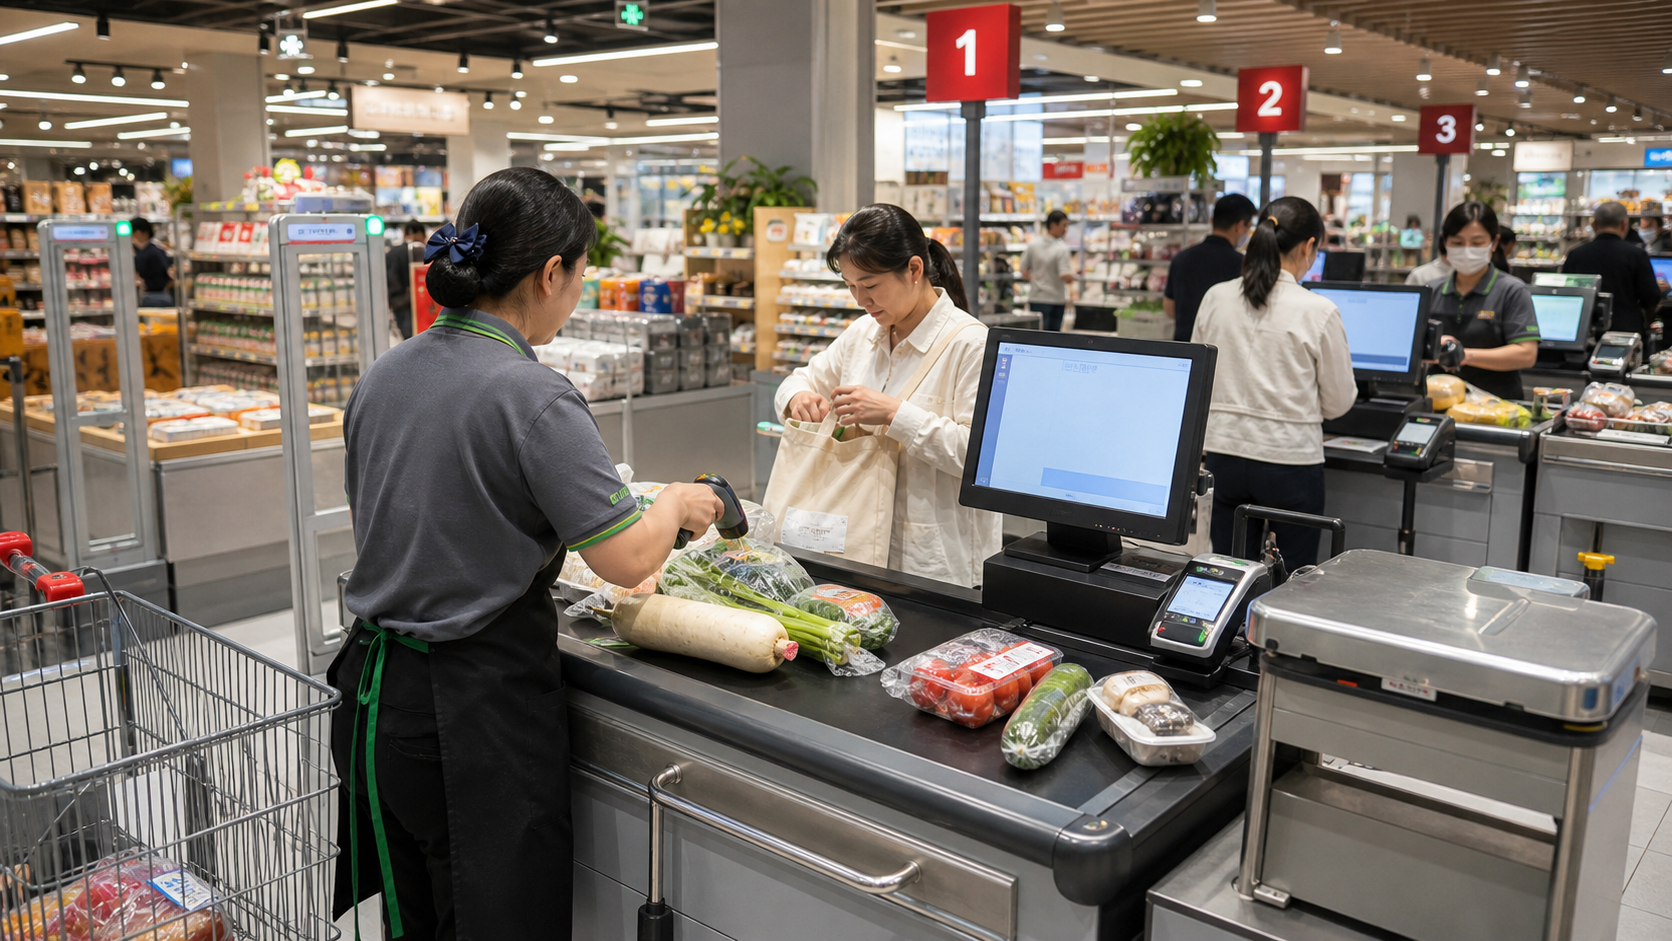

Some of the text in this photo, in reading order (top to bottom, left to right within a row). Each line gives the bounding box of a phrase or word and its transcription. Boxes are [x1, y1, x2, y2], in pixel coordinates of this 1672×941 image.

[955, 29, 977, 77] 1
[1257, 80, 1283, 117] 2
[1435, 114, 1457, 144] 3
